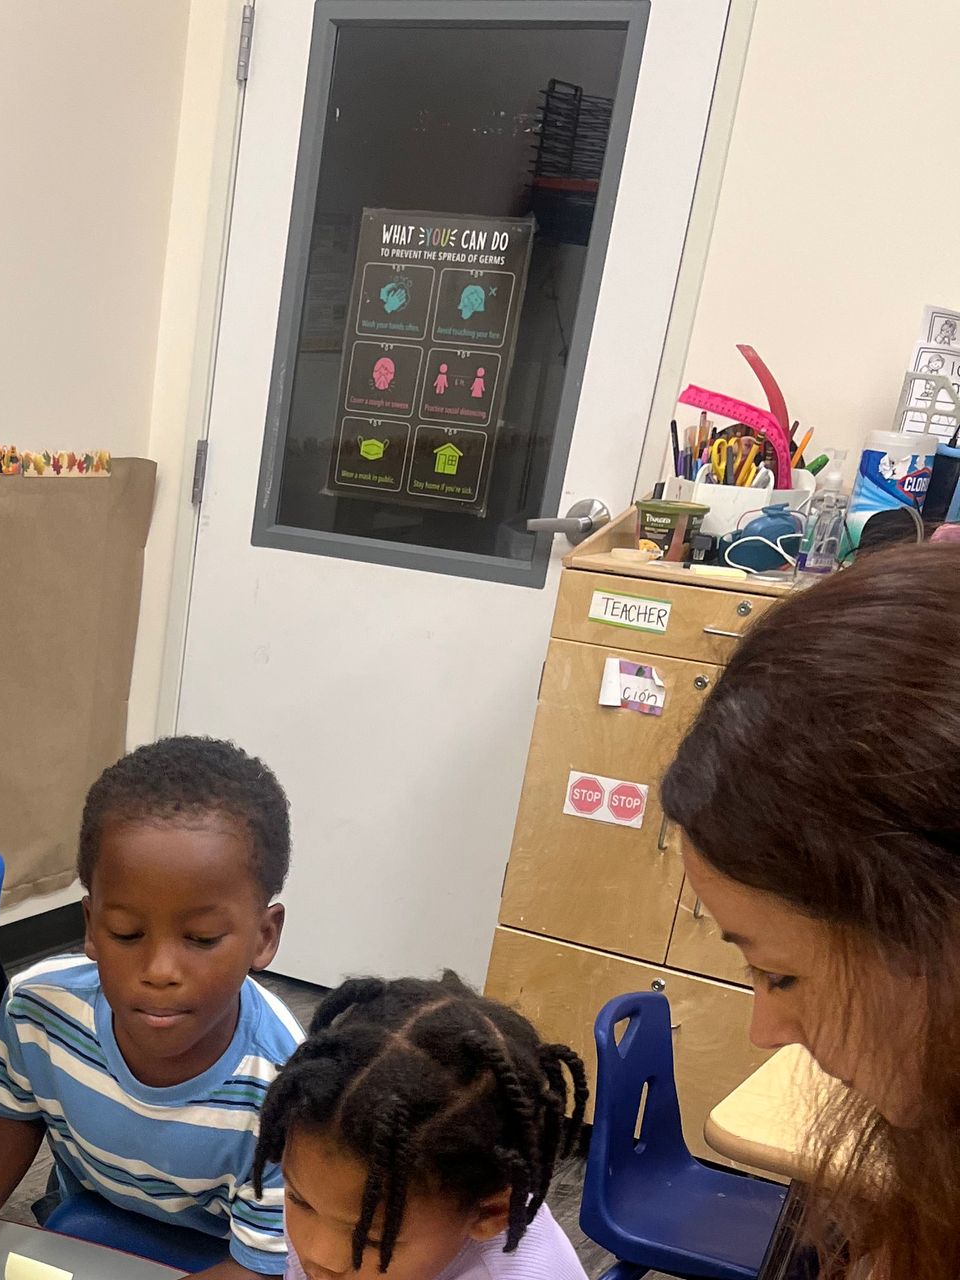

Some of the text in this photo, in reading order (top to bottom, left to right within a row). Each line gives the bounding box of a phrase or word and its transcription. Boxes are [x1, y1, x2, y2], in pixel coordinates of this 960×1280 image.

[382, 224, 509, 250] WHAT YOU CAN DO
[381, 248, 505, 266] TO PREVENT THE SPREAD OF GERMS
[413, 480, 424, 490] Stay
[425, 481, 440, 491] home
[601, 596, 668, 628] TEACHER
[573, 788, 601, 804] STOP
[611, 794, 641, 810] STOP
